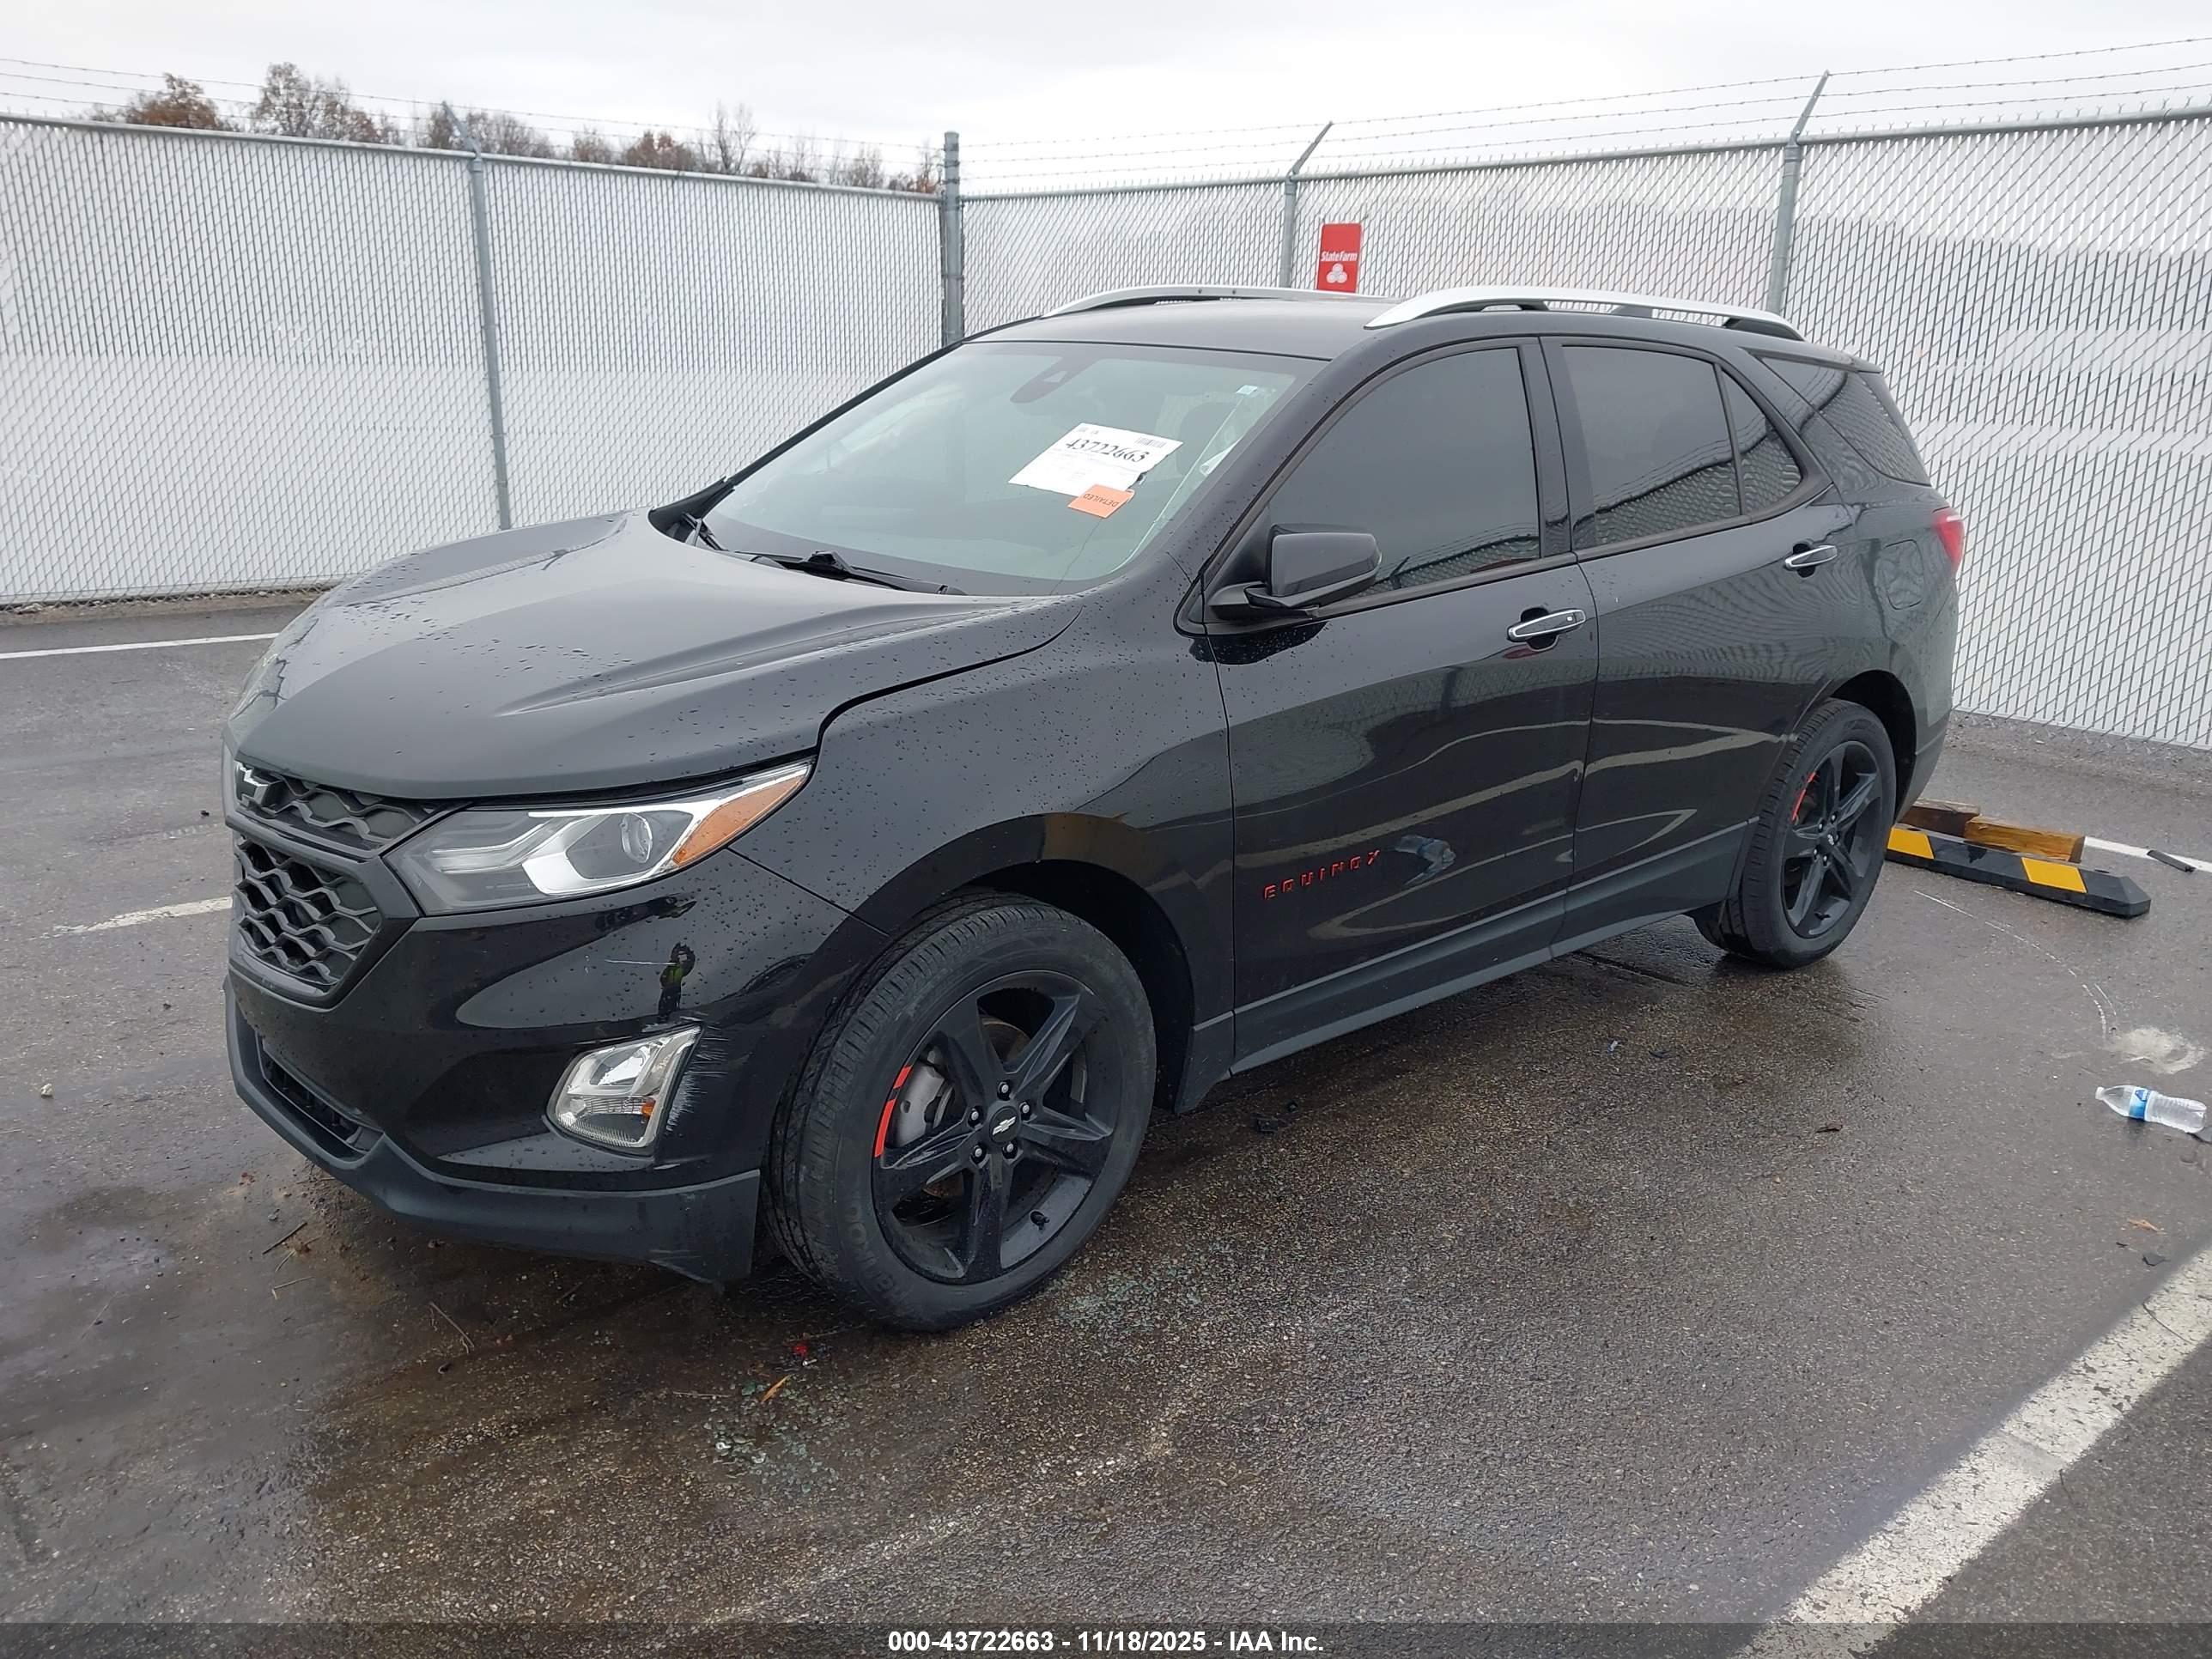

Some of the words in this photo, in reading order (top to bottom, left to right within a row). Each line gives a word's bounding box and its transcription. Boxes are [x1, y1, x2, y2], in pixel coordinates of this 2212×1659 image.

[1065, 437, 1150, 463] 43722663
[1083, 493, 1120, 507] DETAILED
[1263, 849, 1381, 900] EQUINOX
